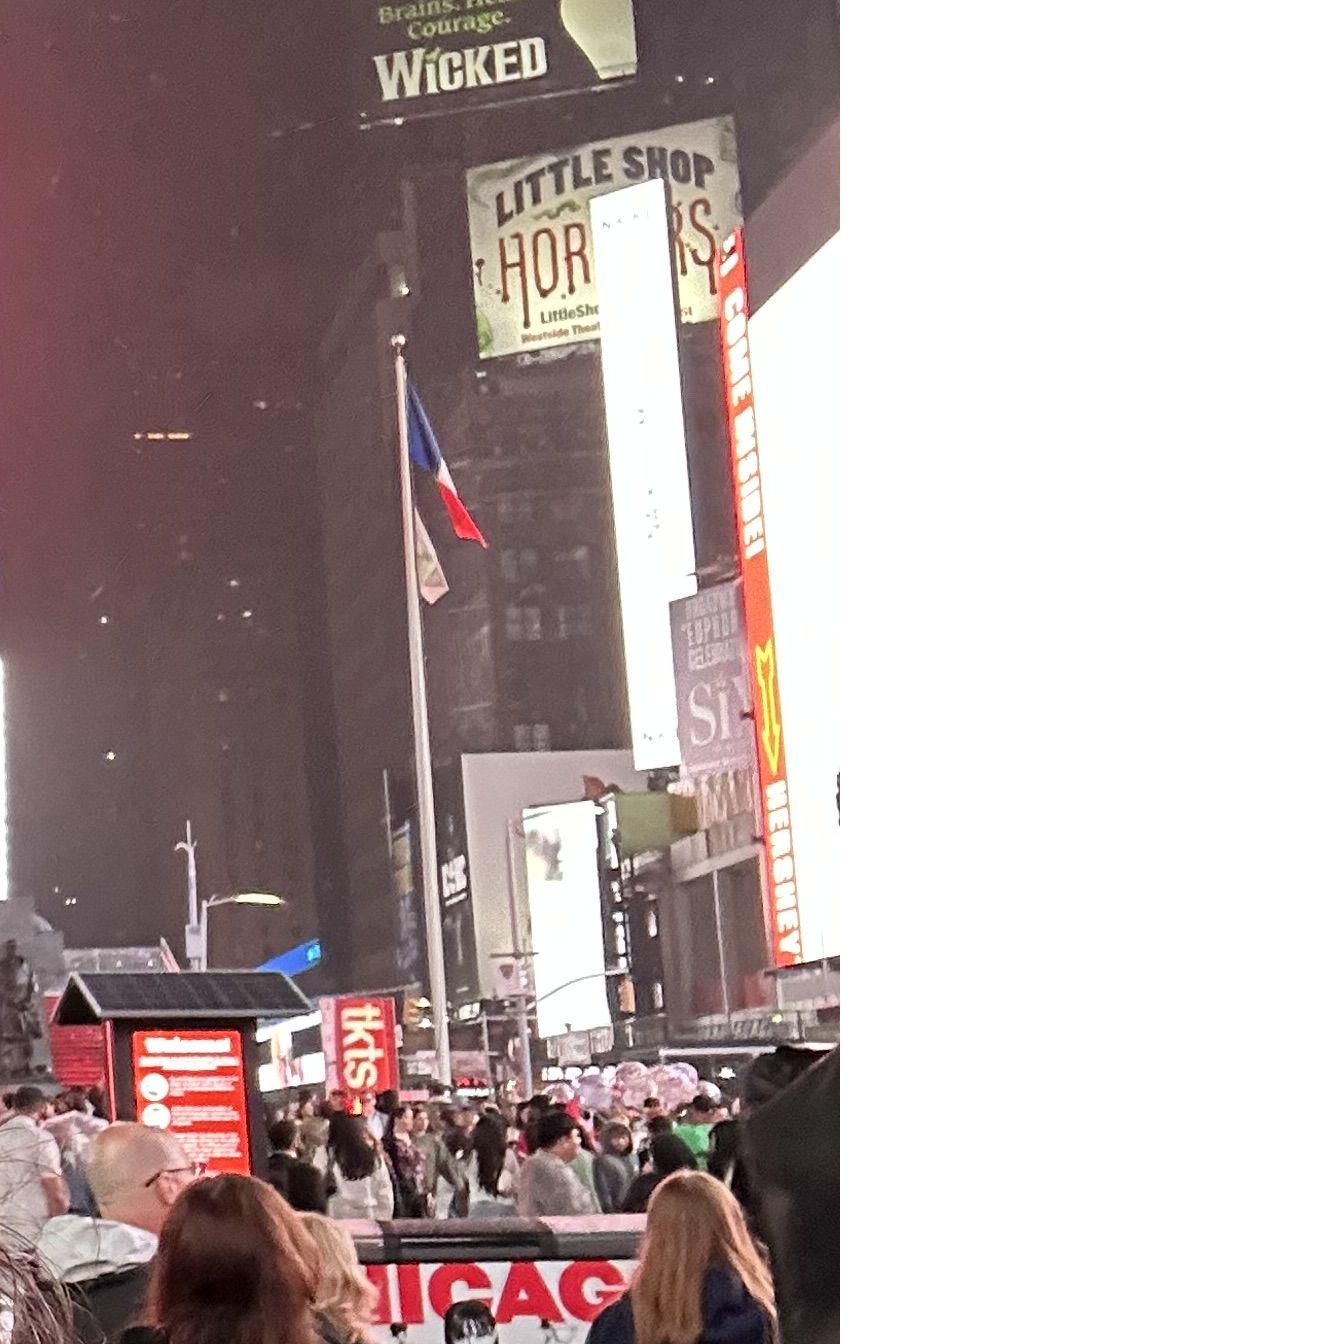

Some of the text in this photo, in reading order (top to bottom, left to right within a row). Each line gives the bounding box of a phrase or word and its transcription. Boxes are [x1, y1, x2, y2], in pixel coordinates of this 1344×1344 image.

[407, 9, 511, 40] Courage.
[496, 145, 715, 228] LITTLE SHOP
[341, 1003, 385, 1089] tkts
